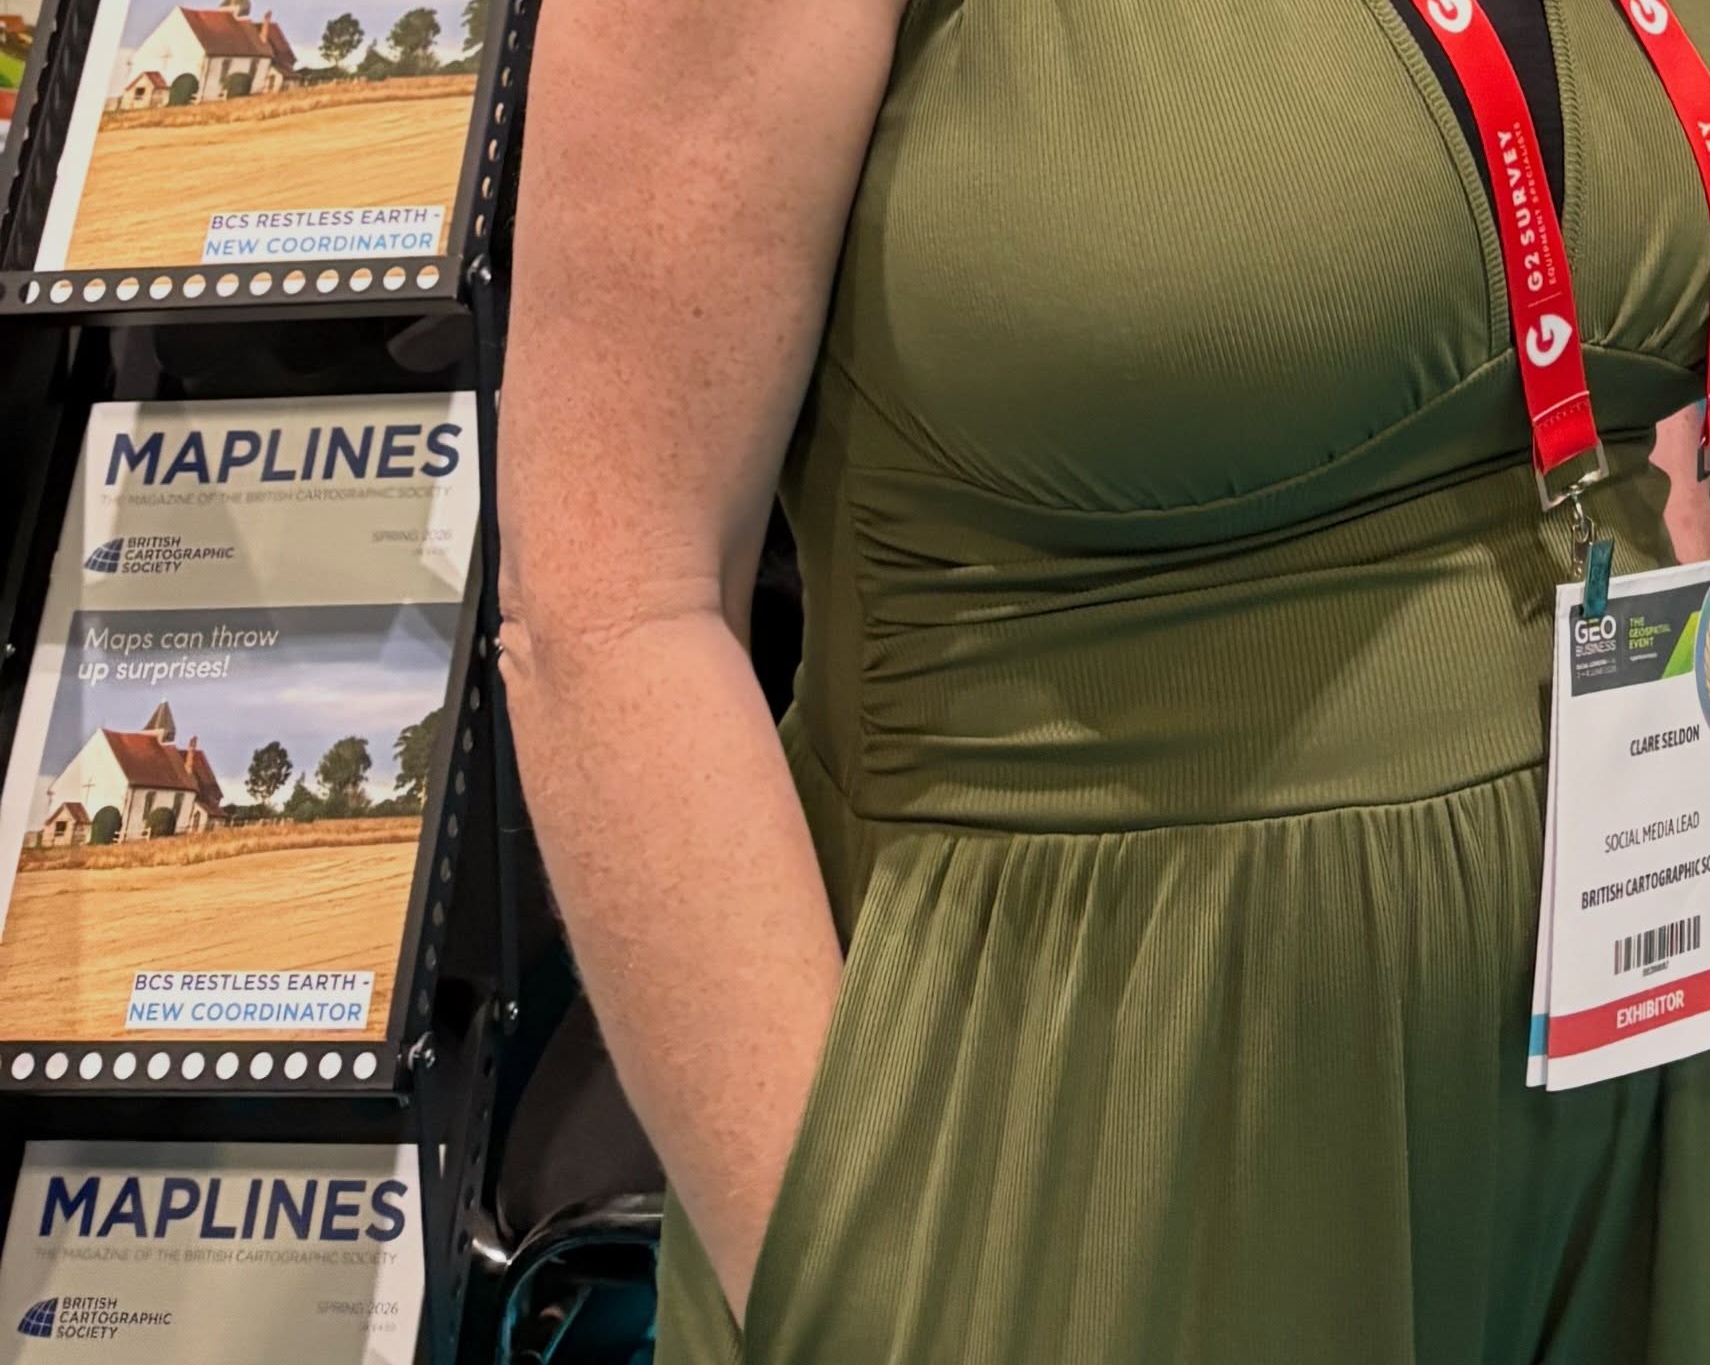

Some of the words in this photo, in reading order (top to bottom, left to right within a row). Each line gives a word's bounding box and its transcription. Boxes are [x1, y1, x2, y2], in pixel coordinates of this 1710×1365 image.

[1497, 129, 1536, 247] SURVEY
[210, 214, 251, 231] BCS
[255, 211, 355, 229] RESTLESS
[360, 208, 429, 226] EARTH
[205, 238, 259, 257] NEW
[266, 232, 435, 255] COORDINATOR
[1524, 251, 1544, 292] G2
[104, 423, 464, 486] MAPLINES
[124, 546, 236, 561] CARTOGRAPHIC
[127, 536, 182, 549] BRITISH
[121, 561, 182, 574] SOCIETY
[83, 627, 154, 655] Maps
[160, 629, 203, 650] can
[210, 623, 280, 649] throw
[1575, 614, 1617, 644] GEO
[77, 660, 110, 687] up
[115, 655, 231, 684] surprises!
[1629, 733, 1661, 757] CLARE
[1661, 724, 1701, 750] SELDON
[1604, 828, 1641, 854] SOCIAL
[1642, 817, 1676, 845] MEDIA
[1675, 810, 1701, 836] LEAD
[1581, 882, 1624, 910] BRITISH
[1625, 857, 1701, 899] CARTOGRAPHIC
[135, 973, 174, 991] BCS
[180, 973, 281, 991] RESTLESS
[287, 973, 357, 991] EARTH
[129, 1002, 185, 1022] NEW
[191, 1002, 363, 1022] COORDINATOR
[1616, 989, 1686, 1031] EXHIBITOR
[39, 1175, 410, 1243] MAPLINES
[61, 1248, 131, 1262] MAGAZINE
[133, 1249, 153, 1262] OF
[156, 1249, 182, 1263] THE
[183, 1250, 235, 1263] BRITISH
[235, 1250, 339, 1266] CARTOGRAPHIC
[340, 1250, 399, 1266] SOCIETY
[62, 1296, 119, 1310] BRITISH
[315, 1301, 365, 1315] SPRING
[59, 1310, 173, 1326] CARTOGRAPHIC
[56, 1325, 119, 1339] SOCIETY
